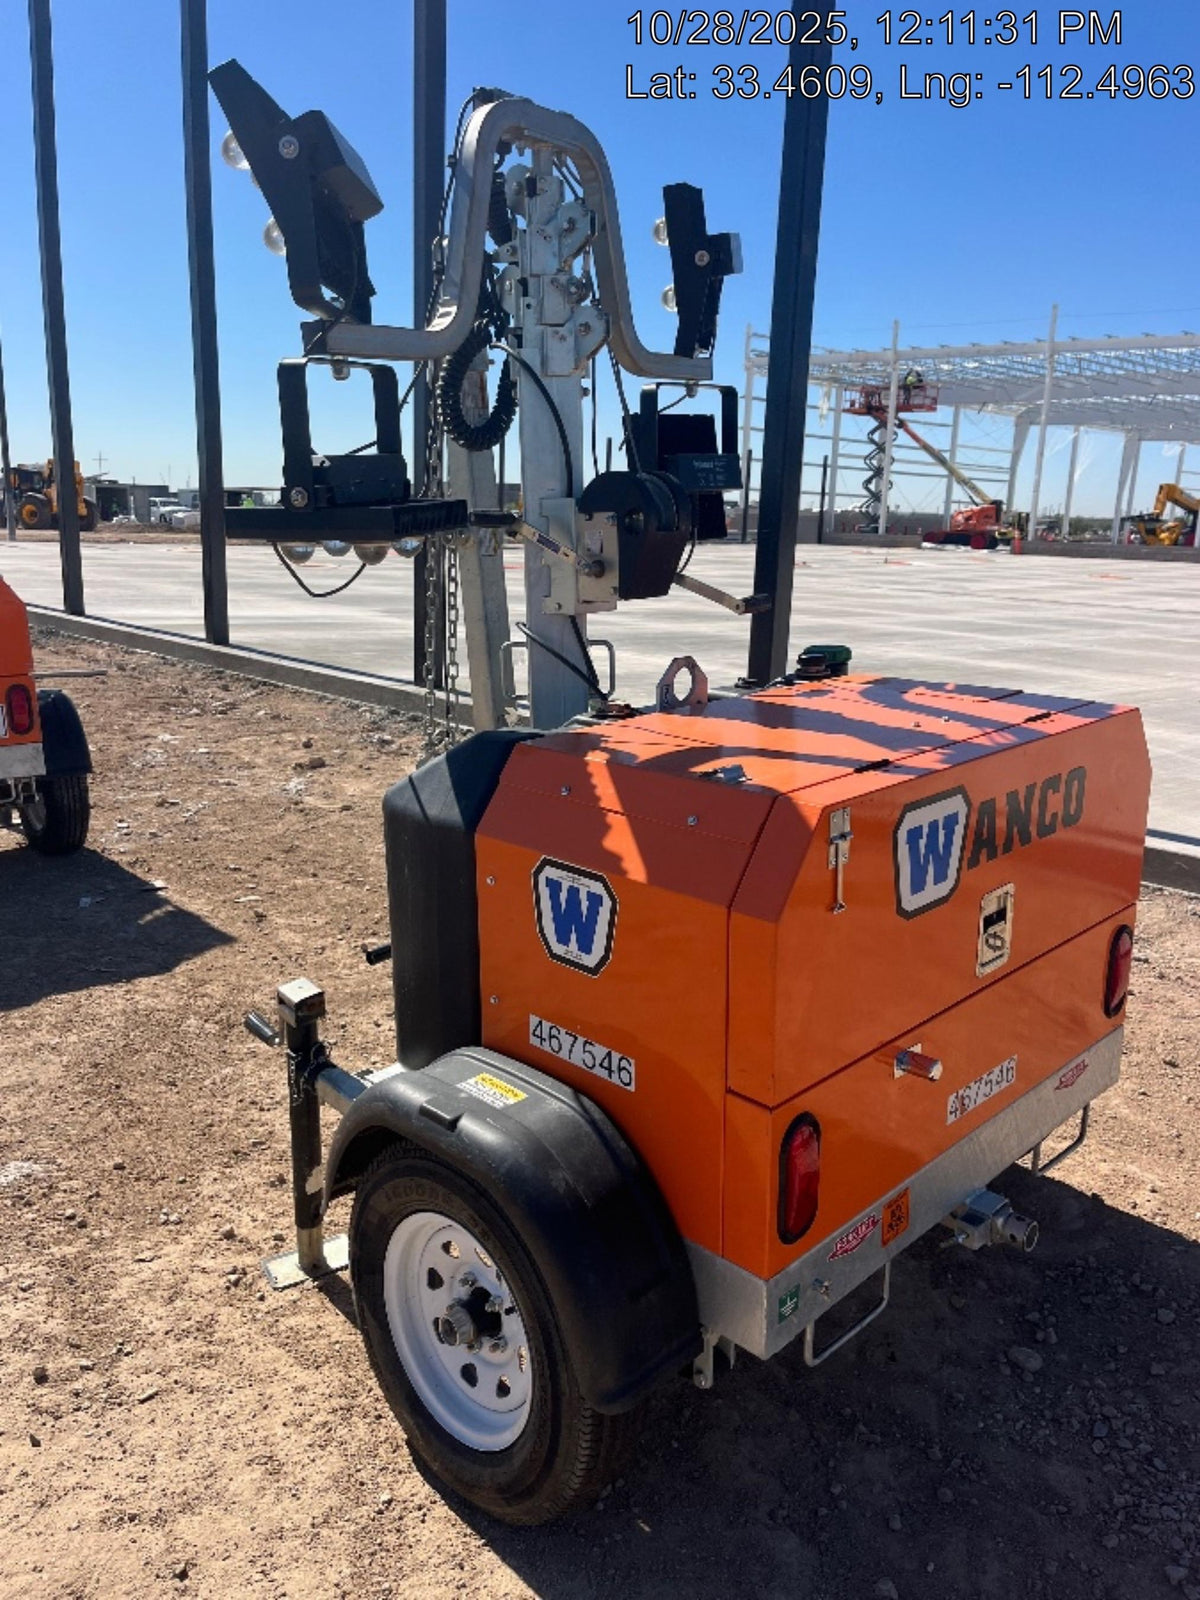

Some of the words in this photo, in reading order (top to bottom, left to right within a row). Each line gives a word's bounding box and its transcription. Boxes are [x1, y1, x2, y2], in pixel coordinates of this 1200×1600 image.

[545, 876, 604, 955] W
[531, 1019, 633, 1087] 467546
[948, 1056, 1016, 1119] 467546
